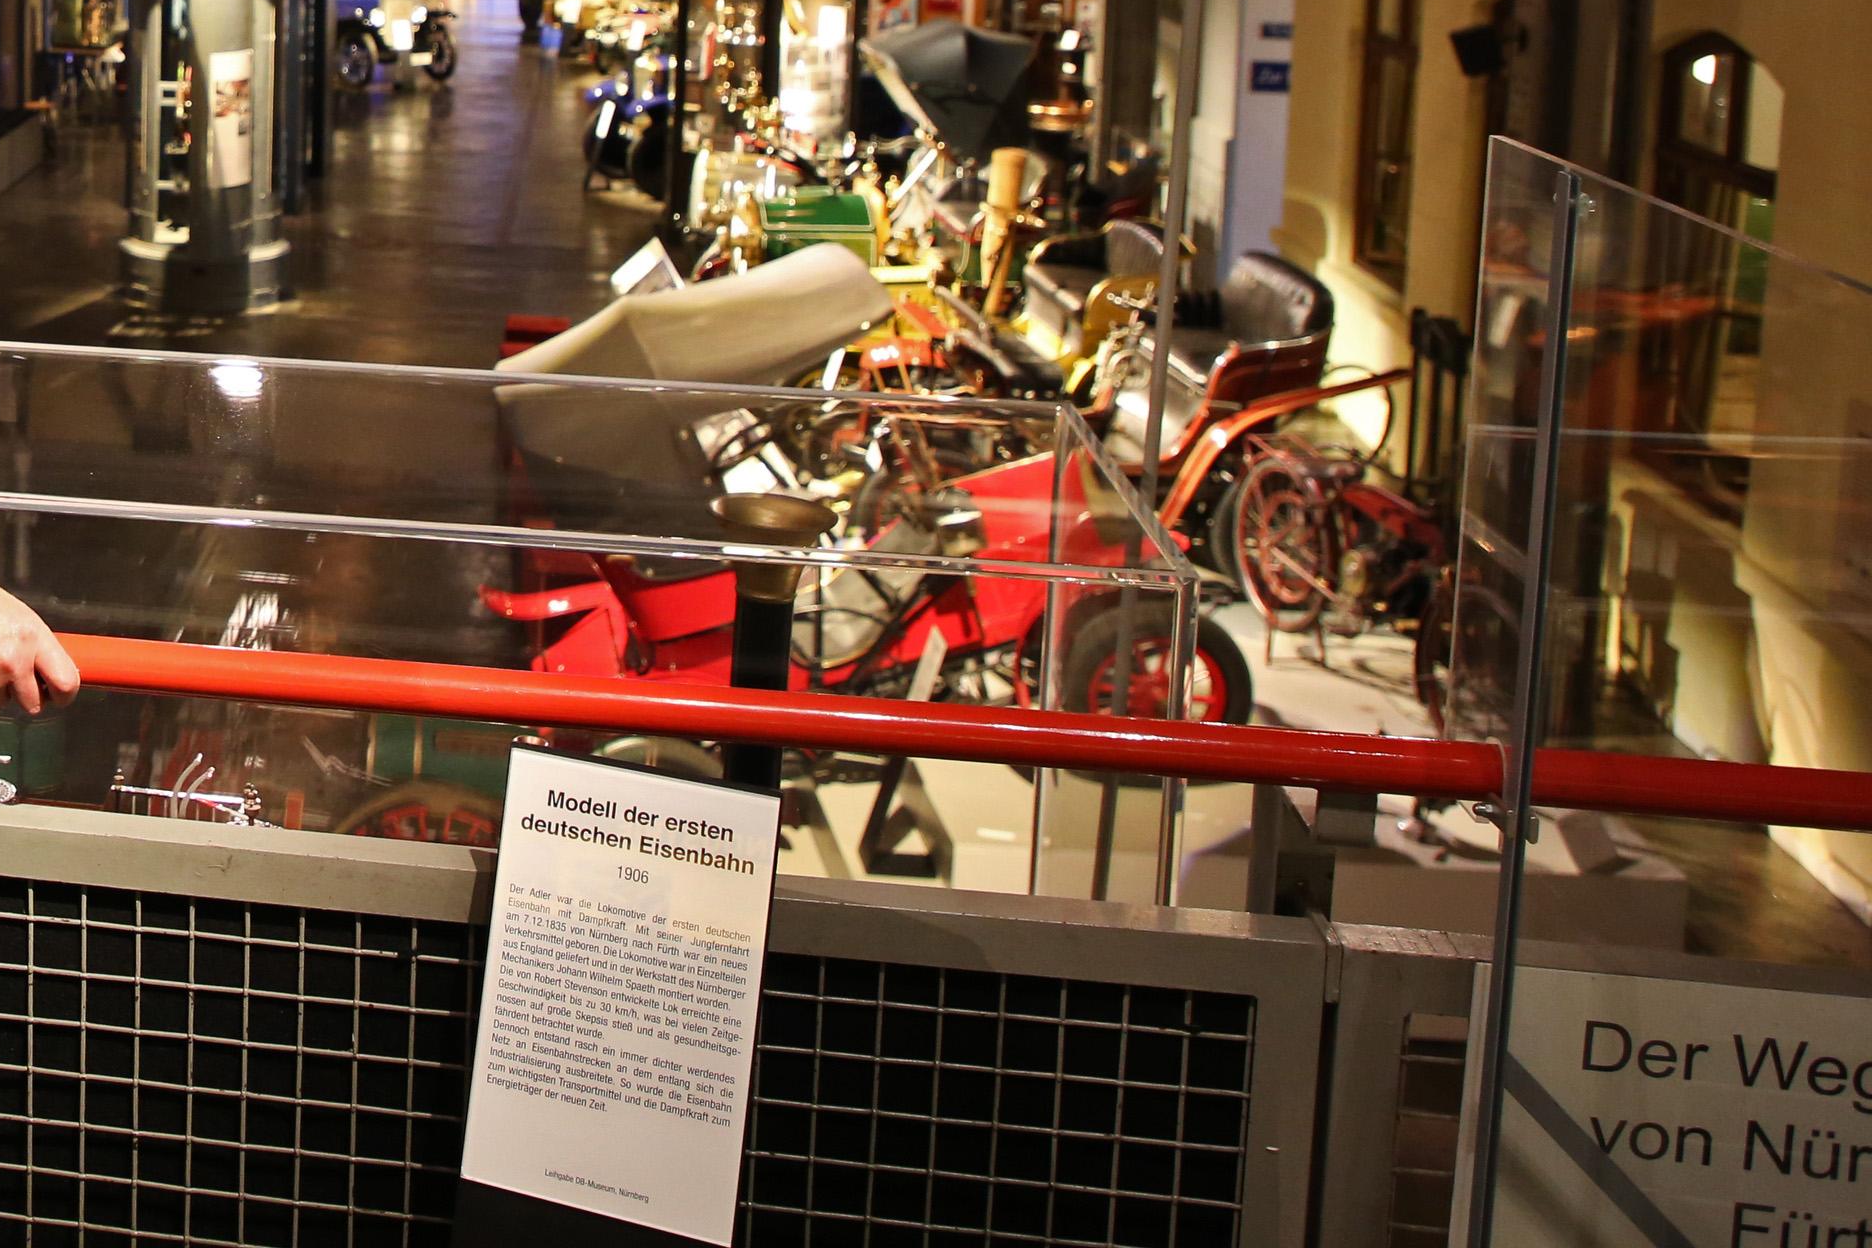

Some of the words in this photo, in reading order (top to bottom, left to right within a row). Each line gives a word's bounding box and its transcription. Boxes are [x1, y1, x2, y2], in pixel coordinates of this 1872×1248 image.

[520, 813, 632, 850] deutschen
[639, 834, 754, 875] Eisenbahn
[547, 789, 617, 820] Modell
[623, 805, 659, 827] der
[664, 816, 734, 843] ersten
[617, 865, 649, 884] 1906
[505, 911, 520, 922] am
[569, 925, 586, 937] von
[588, 927, 629, 948] Nürnberg
[631, 939, 654, 952] nach
[656, 942, 680, 957] Fürth
[682, 950, 701, 961] war
[702, 952, 718, 965] ein
[720, 957, 748, 971] neues
[507, 896, 551, 916] Eisenbahn
[557, 908, 572, 920] mit
[634, 923, 650, 936] Mit
[655, 930, 684, 943] seiner
[509, 882, 525, 895] Der
[528, 887, 552, 901] Adler
[556, 895, 573, 905] war
[578, 898, 592, 910] die
[596, 901, 647, 921] Lokomotive
[651, 913, 667, 925] der
[671, 919, 700, 933] ersten
[704, 924, 751, 943] deutschen
[501, 950, 555, 972] Mechanikers
[555, 963, 588, 980] Johann
[588, 969, 623, 987] Wilhelm
[624, 978, 656, 995] Spaeth
[657, 987, 694, 1003] montiert
[502, 938, 519, 950] aus
[519, 940, 554, 958] England
[554, 950, 590, 966] geliefert
[590, 958, 609, 970] und
[608, 959, 618, 972] in
[618, 963, 635, 975] der
[635, 965, 677, 985] Werkstatt
[677, 976, 695, 989] des
[695, 979, 747, 1000] Nürnberger
[504, 923, 565, 946] Verkehrsmittel
[602, 944, 618, 958] Die
[618, 947, 668, 969] Lokomotive
[668, 961, 687, 972] war
[686, 962, 696, 975] in
[696, 965, 747, 986] Einzelteilen
[495, 993, 527, 1008] nossen
[528, 1000, 544, 1012] auf
[546, 1004, 572, 1018] große
[574, 1009, 609, 1027] Skepsis
[611, 1018, 633, 1032] stieß
[636, 1025, 654, 1037] und
[656, 1029, 671, 1041] als
[673, 1034, 741, 1057] gesundheitsge-
[497, 977, 567, 1004] Geschwindigkeit
[568, 993, 583, 1007] bis
[584, 999, 597, 1010] zu
[599, 1001, 612, 1013] 30
[642, 1012, 662, 1025] was
[664, 1015, 679, 1029] bei
[681, 1020, 708, 1035] vielen
[710, 1025, 743, 1043] Zeitge-
[499, 963, 514, 977] Die
[515, 969, 532, 981] von
[533, 971, 562, 988] Robert
[563, 978, 608, 998] Stevenson
[609, 991, 660, 1010] entwickelte
[661, 1000, 679, 1014] Lok
[680, 1006, 720, 1024] erreichte
[722, 1015, 742, 1028] eine
[492, 1018, 530, 1037] Dennoch
[533, 1029, 571, 1046] entstand
[573, 1039, 599, 1053] rasch
[601, 1045, 616, 1057] ein
[619, 1047, 649, 1065] immer
[651, 1056, 683, 1073] dichter
[686, 1066, 735, 1085] werdendes
[530, 1013, 575, 1033] betrachtet
[575, 1025, 605, 1040] wurde.
[1582, 1020, 1709, 1080] Der
[486, 1072, 543, 1096] Energieträger
[544, 1087, 559, 1100] der
[560, 1093, 587, 1107] neuen
[588, 1097, 607, 1112] Zeit.
[487, 1061, 506, 1073] zum
[508, 1065, 556, 1086] wichtigsten
[558, 1076, 623, 1101] Transportmittel
[623, 1094, 642, 1106] und
[643, 1097, 658, 1110] die
[659, 1100, 709, 1123] Dampfkraft
[710, 1114, 731, 1128] zum
[489, 1045, 562, 1075] Industrialisierung
[619, 1076, 632, 1090] So
[635, 1082, 664, 1097] wurde
[667, 1089, 682, 1102] die
[686, 1092, 732, 1113] Eisenbahn
[491, 1032, 511, 1046] Netz
[514, 1039, 527, 1050] an
[531, 1041, 611, 1070] Eisenbahnstrecken
[615, 1063, 628, 1074] an
[632, 1066, 653, 1080] dem
[657, 1073, 691, 1091] entlang
[695, 1081, 715, 1095] sich
[719, 1086, 734, 1099] die
[1590, 1117, 1712, 1166] von
[618, 1187, 650, 1204] Nürnberg
